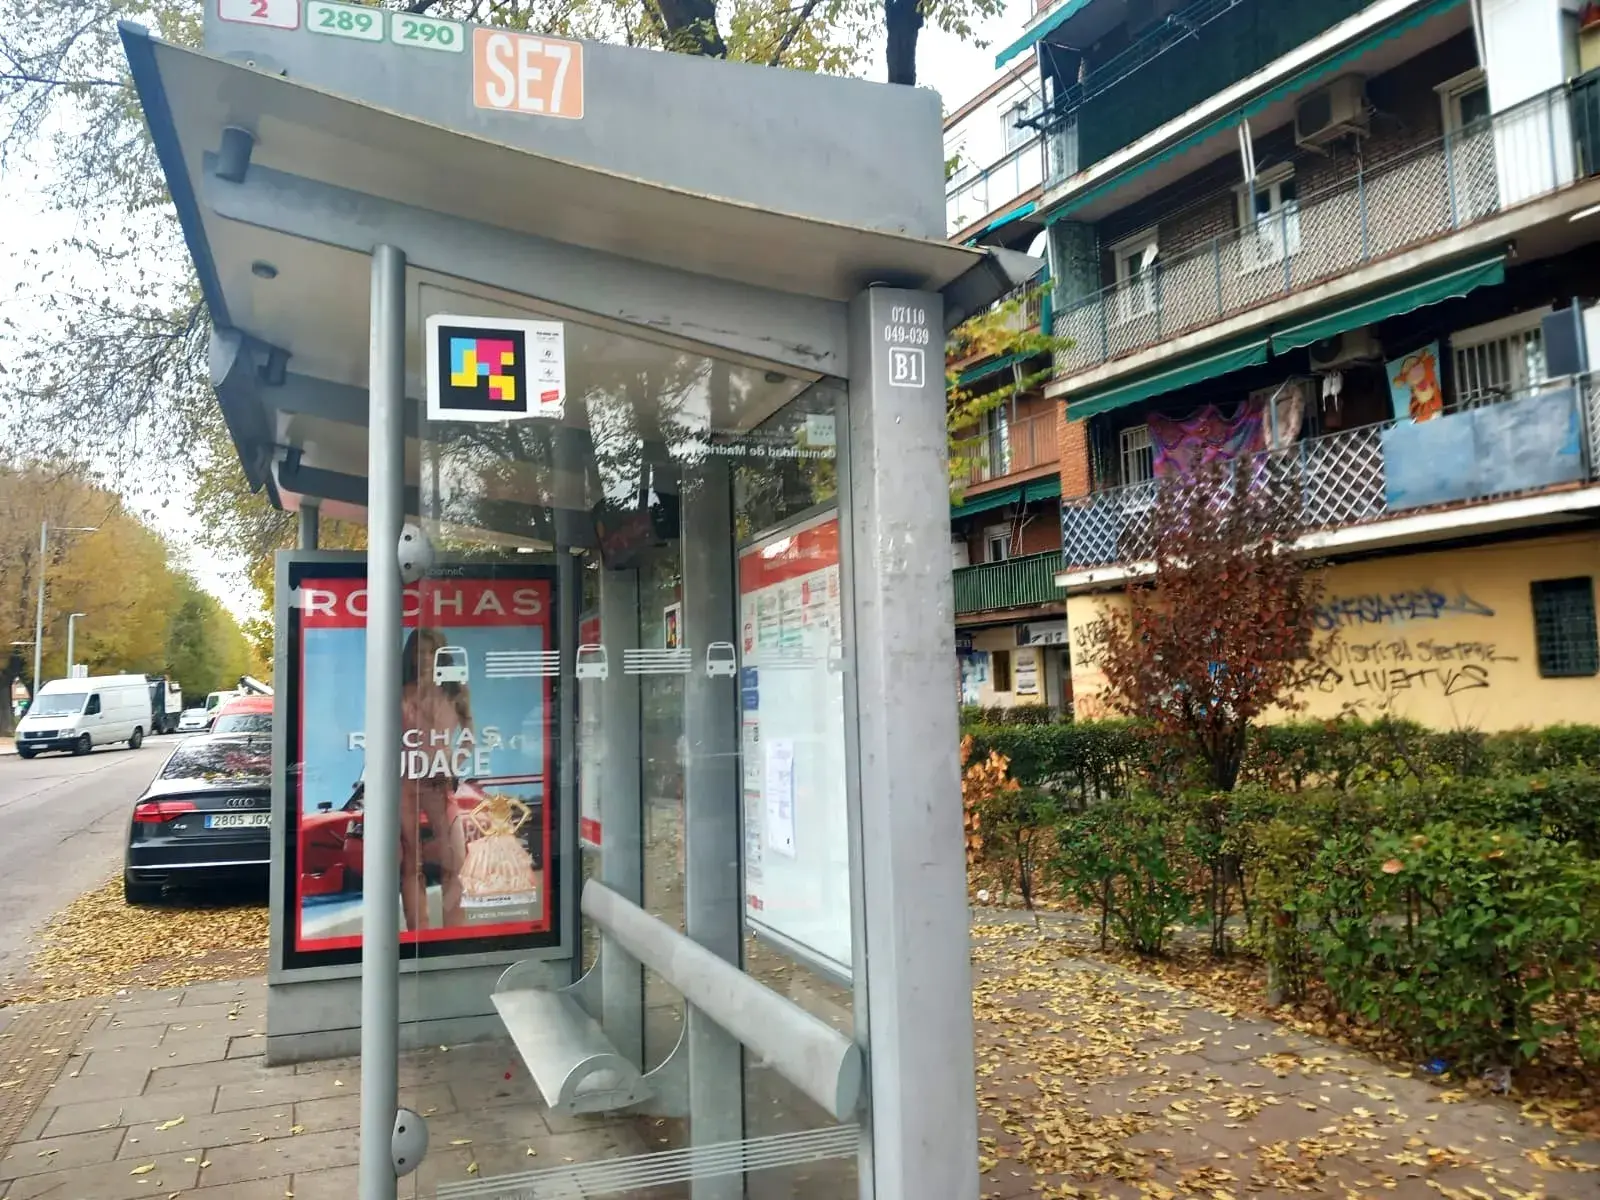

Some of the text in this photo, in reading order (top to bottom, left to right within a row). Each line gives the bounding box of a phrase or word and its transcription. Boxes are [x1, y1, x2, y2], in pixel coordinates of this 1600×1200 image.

[318, 8, 373, 33] 289
[401, 20, 455, 45] 290
[486, 33, 572, 113] SE7
[891, 305, 925, 325] 07110
[884, 325, 929, 345] 049-039
[895, 353, 918, 380] B1
[348, 726, 500, 751] RCHAS
[214, 815, 244, 827] 2805
